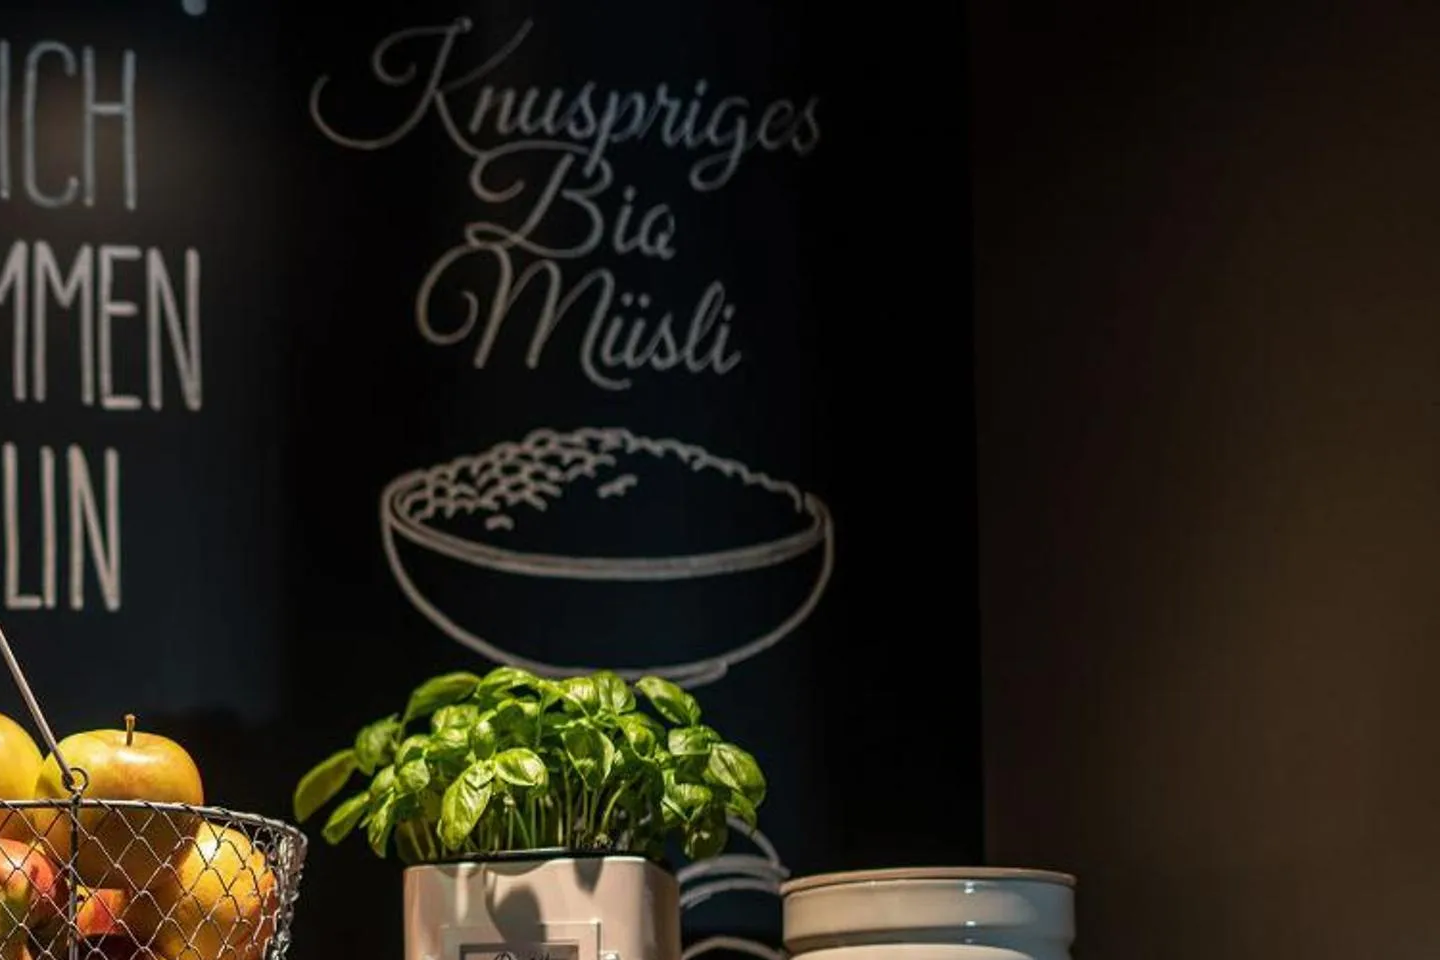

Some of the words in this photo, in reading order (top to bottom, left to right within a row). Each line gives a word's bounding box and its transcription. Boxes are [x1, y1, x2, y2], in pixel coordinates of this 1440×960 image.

[310, 17, 821, 191] Knuspriges
[466, 139, 677, 260] Bio
[416, 240, 742, 391] Müsli
